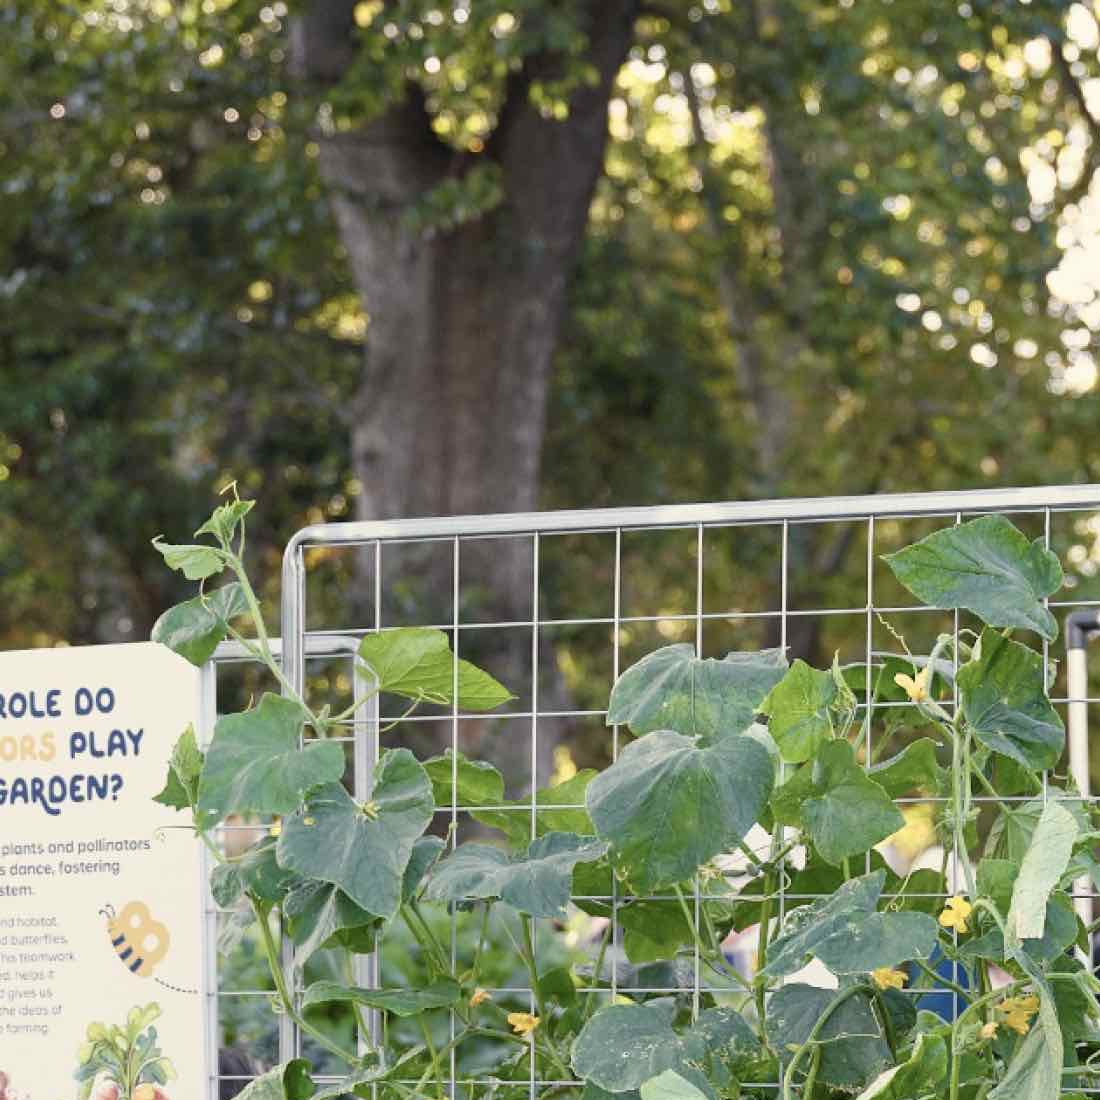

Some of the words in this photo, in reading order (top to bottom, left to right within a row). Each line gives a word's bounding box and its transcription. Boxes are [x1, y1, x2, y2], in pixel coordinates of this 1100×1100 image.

[75, 687, 115, 716] DO
[70, 728, 144, 758] PLAY
[2, 842, 44, 856] plants
[48, 841, 74, 854] and
[78, 838, 151, 854] pollinators
[9, 863, 54, 876] dance,
[59, 860, 120, 875] fostering
